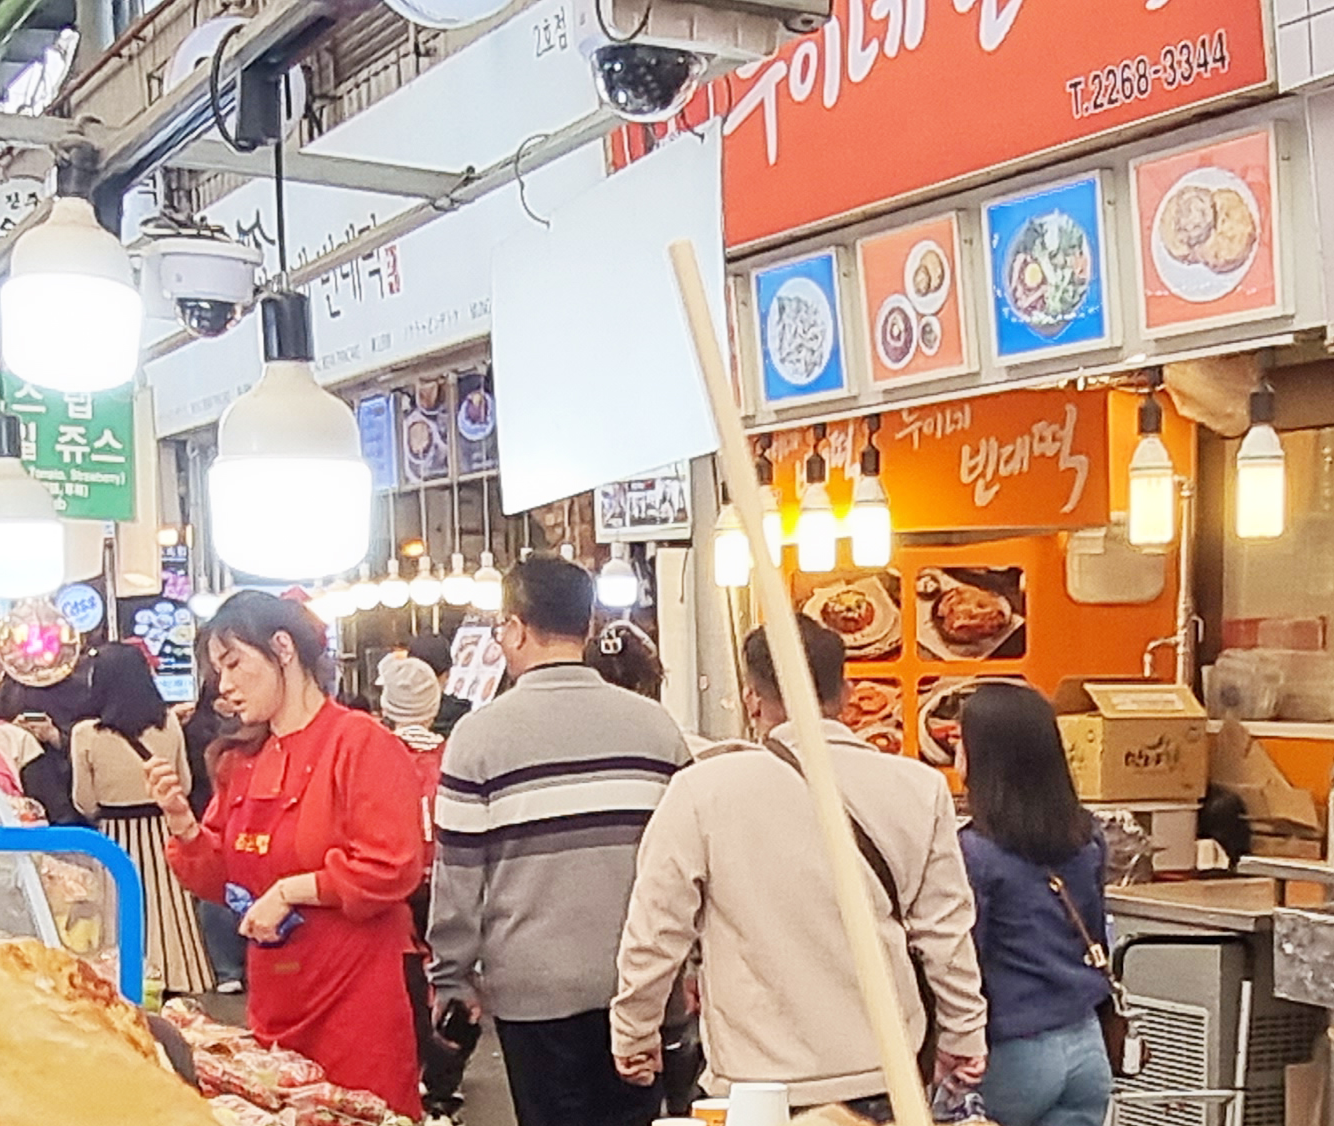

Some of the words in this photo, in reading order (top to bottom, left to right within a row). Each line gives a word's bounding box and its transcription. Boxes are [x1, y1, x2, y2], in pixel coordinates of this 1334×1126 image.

[533, 6, 568, 58] 2호점
[1066, 30, 1229, 117] T.2268-3344
[54, 424, 126, 465] 쥬스
[960, 402, 1089, 514] 빈대떡
